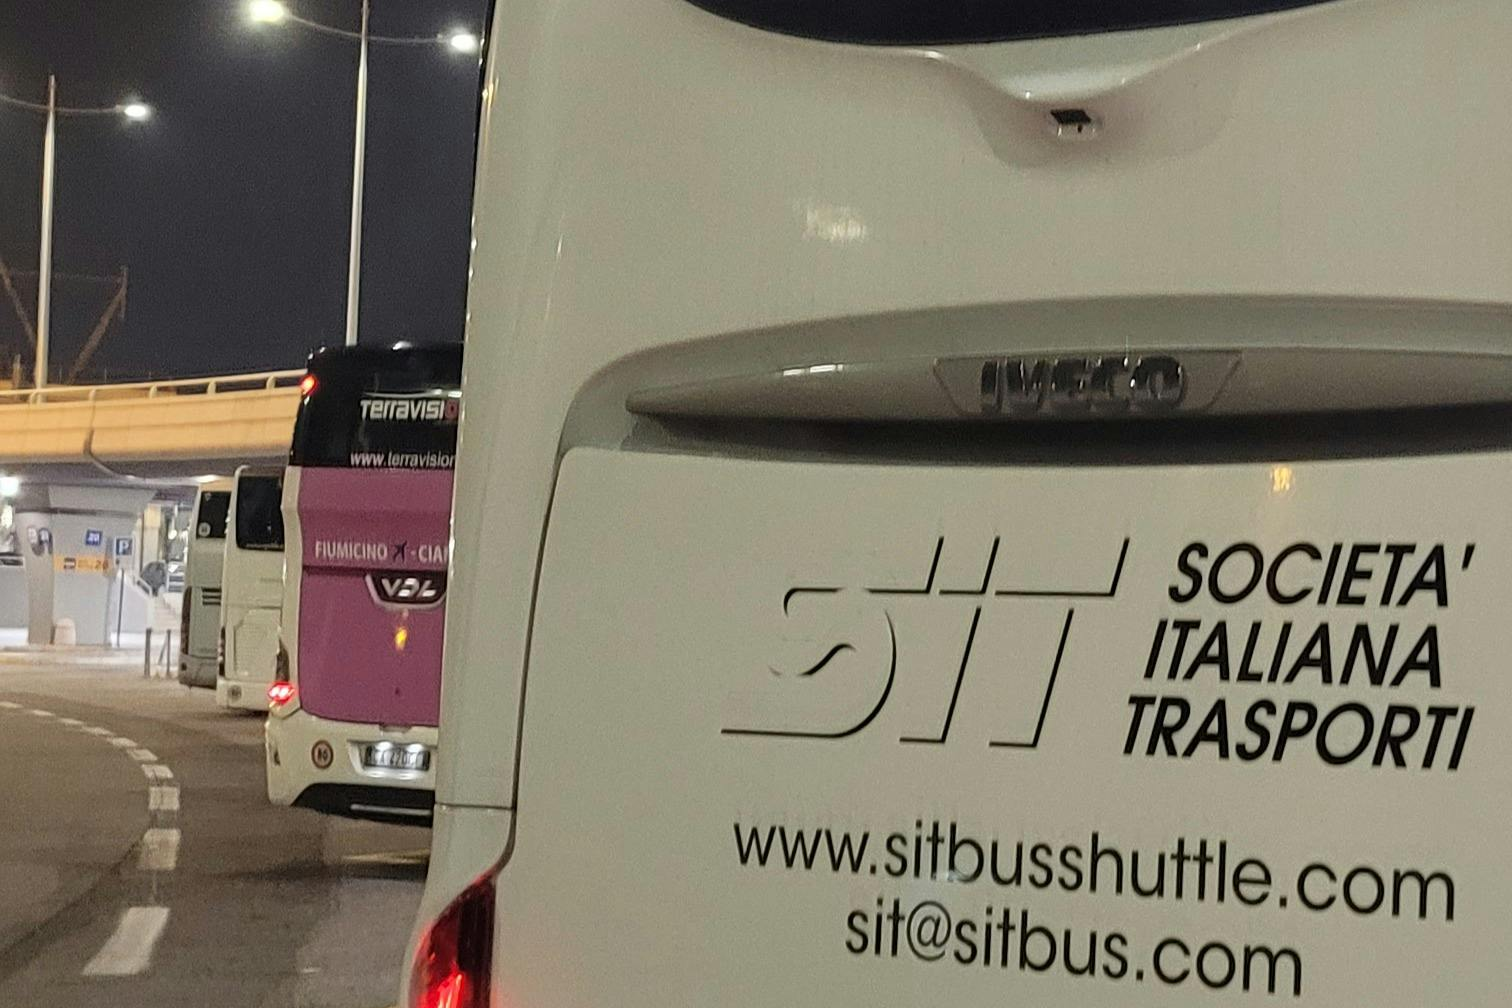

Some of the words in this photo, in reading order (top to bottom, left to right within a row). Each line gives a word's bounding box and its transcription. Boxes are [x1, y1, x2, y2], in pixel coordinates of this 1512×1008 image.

[981, 356, 1185, 412] IVECO
[315, 540, 388, 561] FIUMICINO
[1168, 542, 1476, 607] SOCIETA'
[1144, 618, 1442, 688] ITALIANA
[1122, 694, 1476, 771] TRASPORTI
[732, 819, 1457, 922] www.sitbusshuttle.com
[845, 897, 1302, 997] sit@sitbus.com
